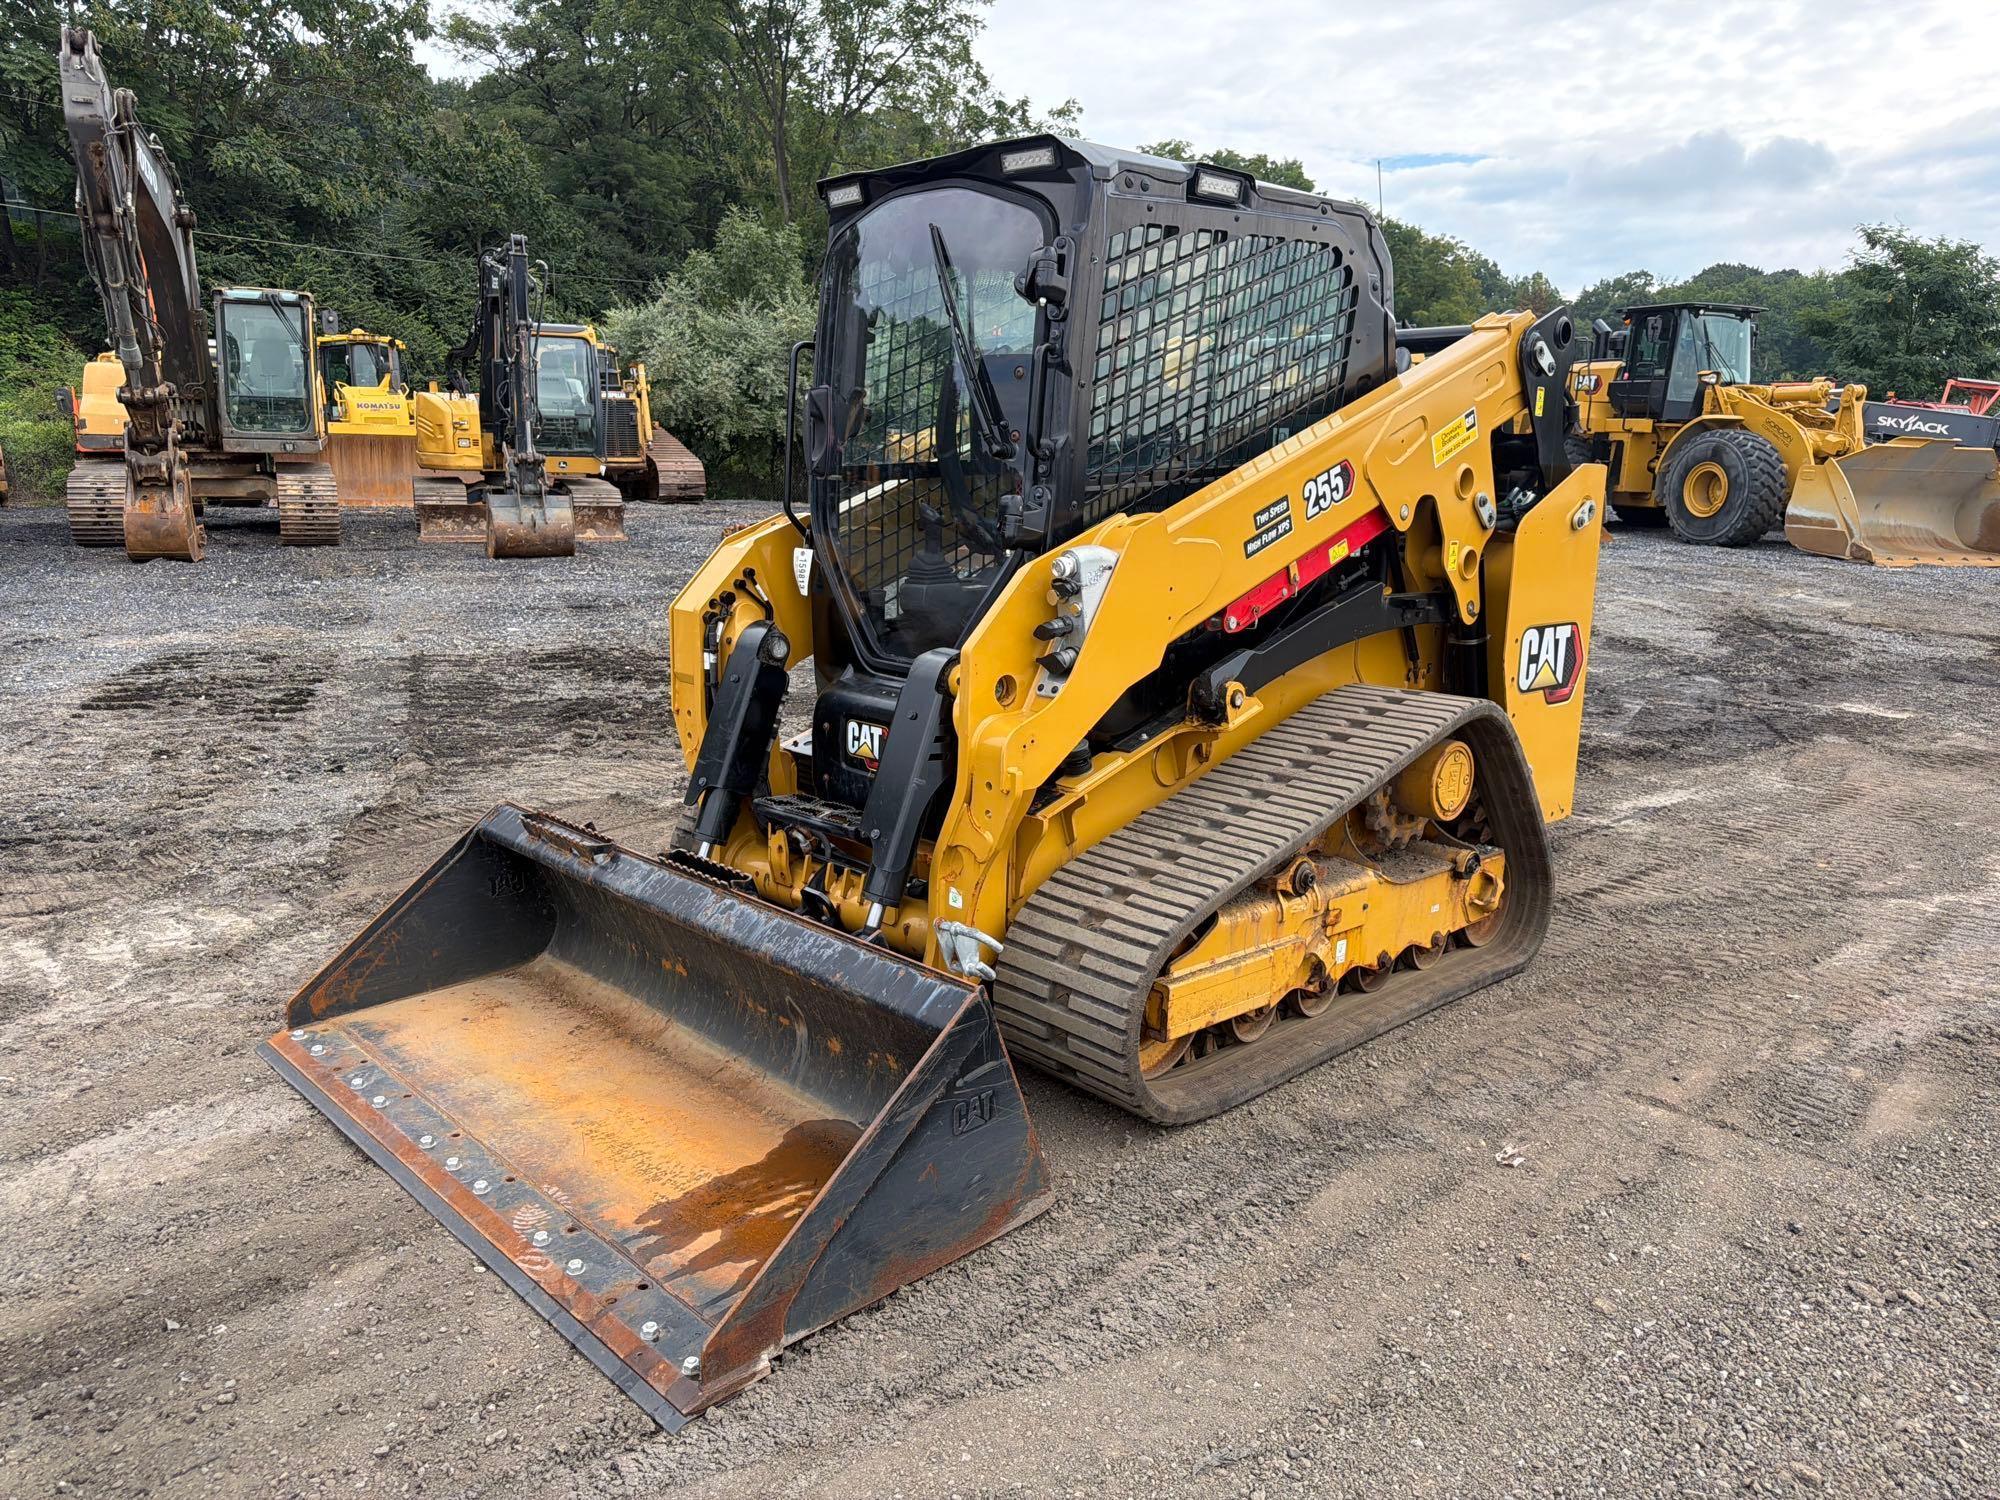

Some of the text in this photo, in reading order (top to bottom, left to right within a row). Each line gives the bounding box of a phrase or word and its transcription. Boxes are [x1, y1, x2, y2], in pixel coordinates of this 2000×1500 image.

[1575, 375, 1597, 391] CAT
[1765, 416, 1794, 442] GORDON
[1877, 414, 1950, 435] SKYJACK
[1304, 464, 1345, 518] 255
[1277, 519, 1290, 535] XPS
[1519, 624, 1572, 691] CAT
[848, 721, 882, 760] CAT
[953, 1090, 993, 1136] CAT
